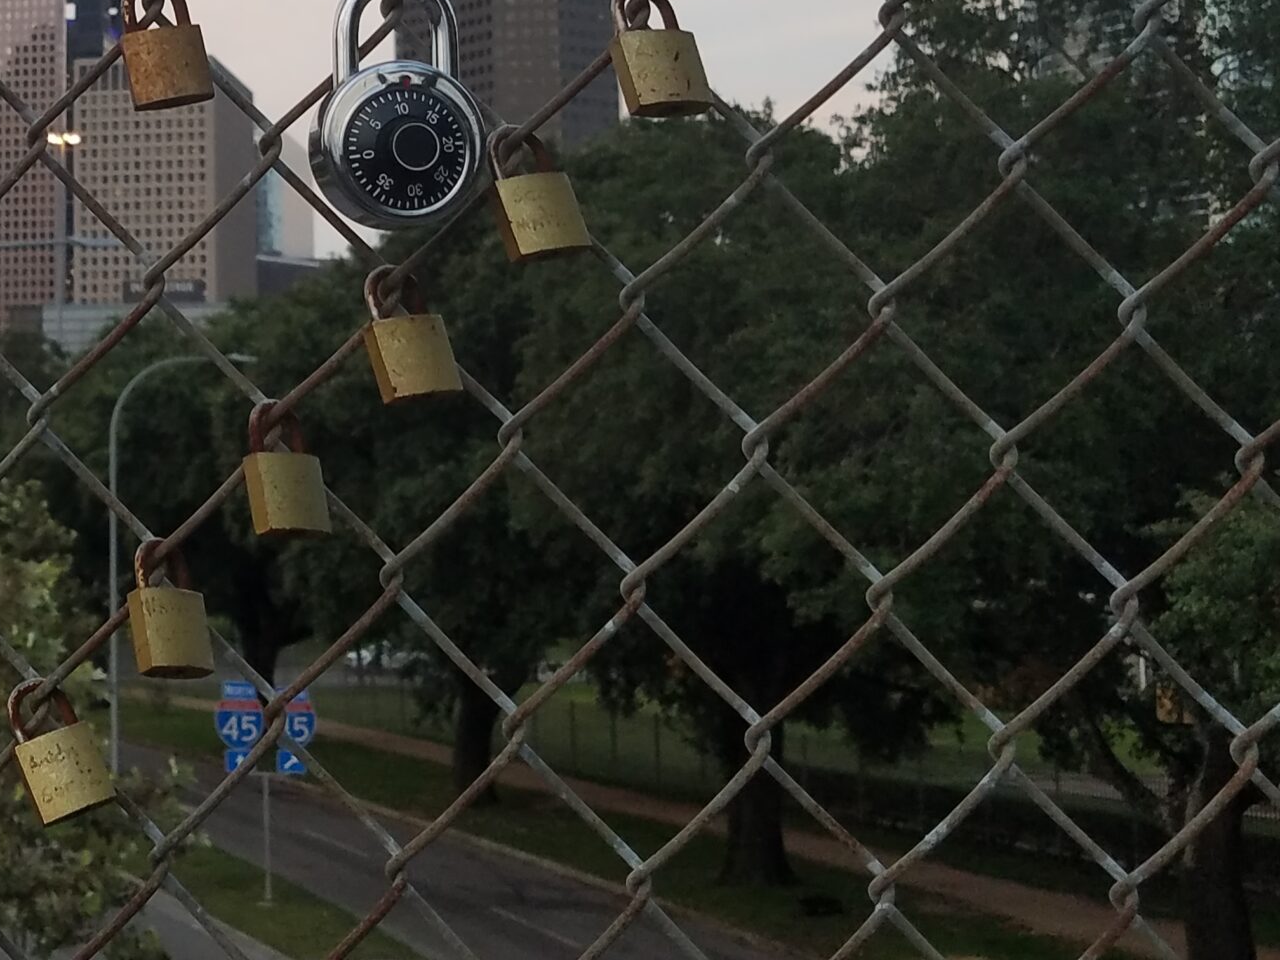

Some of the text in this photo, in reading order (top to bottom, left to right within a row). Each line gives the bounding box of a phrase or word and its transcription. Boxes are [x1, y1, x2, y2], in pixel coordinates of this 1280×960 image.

[394, 102, 409, 116] 10
[425, 109, 440, 125] 15
[370, 118, 382, 131] 5
[441, 136, 454, 153] 20
[362, 149, 375, 160] 0
[375, 172, 395, 190] 35
[433, 165, 449, 184] 25
[407, 183, 423, 197] 30
[221, 714, 258, 742] 45
